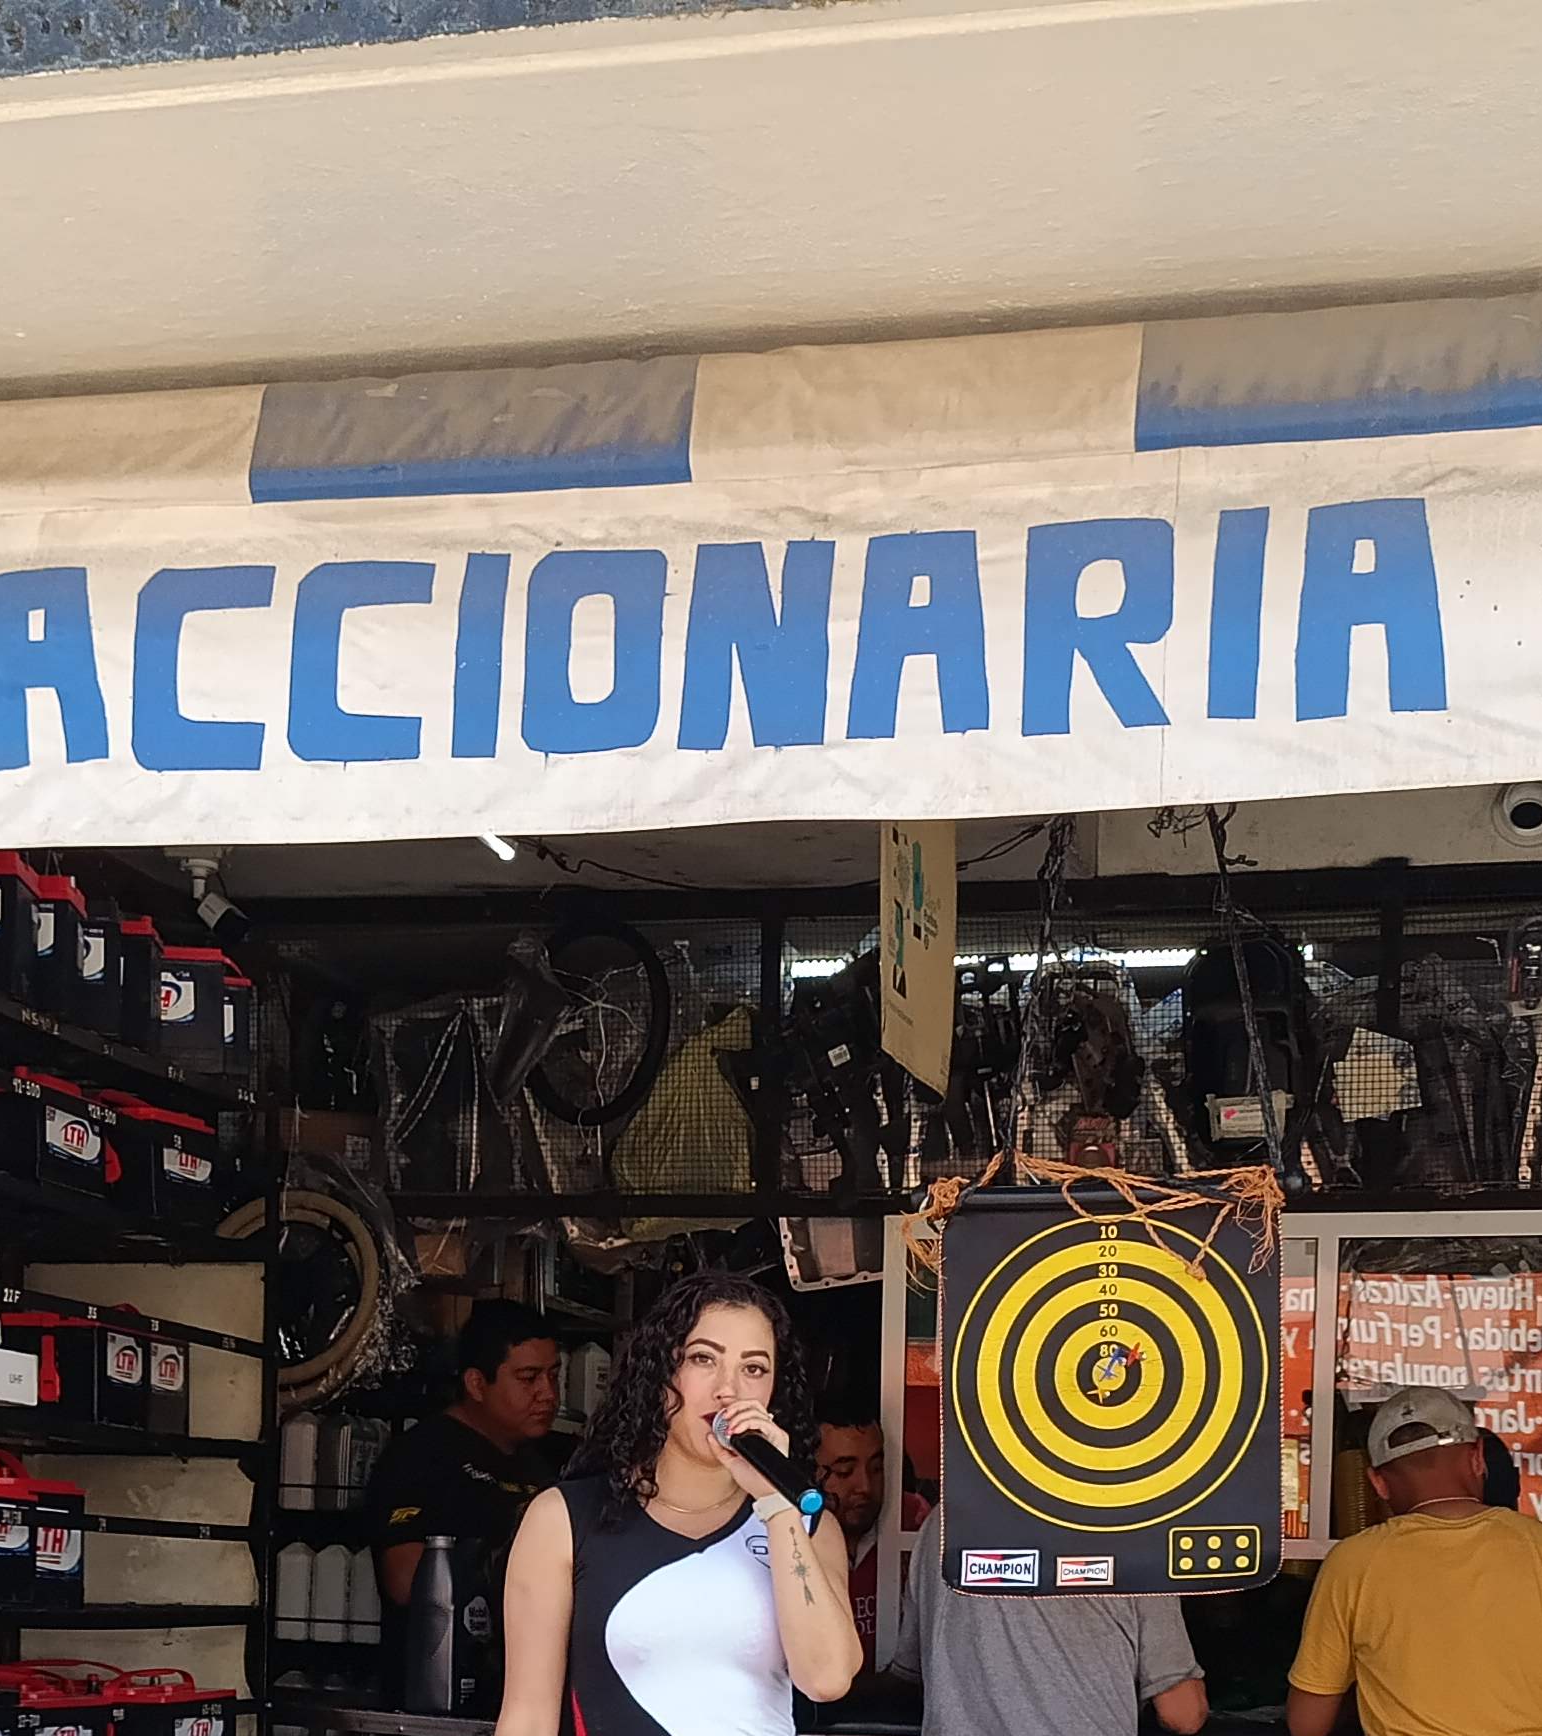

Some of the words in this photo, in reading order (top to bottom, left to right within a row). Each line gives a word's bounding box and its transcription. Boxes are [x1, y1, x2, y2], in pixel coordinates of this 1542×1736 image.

[64, 1123, 86, 1147] LTH
[1100, 1226, 1118, 1239] 10
[1099, 1246, 1118, 1258] 20
[1099, 1265, 1118, 1278] 30
[1099, 1284, 1118, 1297] 40
[1099, 1304, 1119, 1318] 50
[1099, 1325, 1118, 1338] 60
[1100, 1344, 1118, 1357] 80
[115, 1350, 139, 1375] LTH
[158, 1357, 180, 1379] LTH
[969, 1562, 1032, 1576] CHAMPION
[1062, 1566, 1108, 1576] CHAMPION
